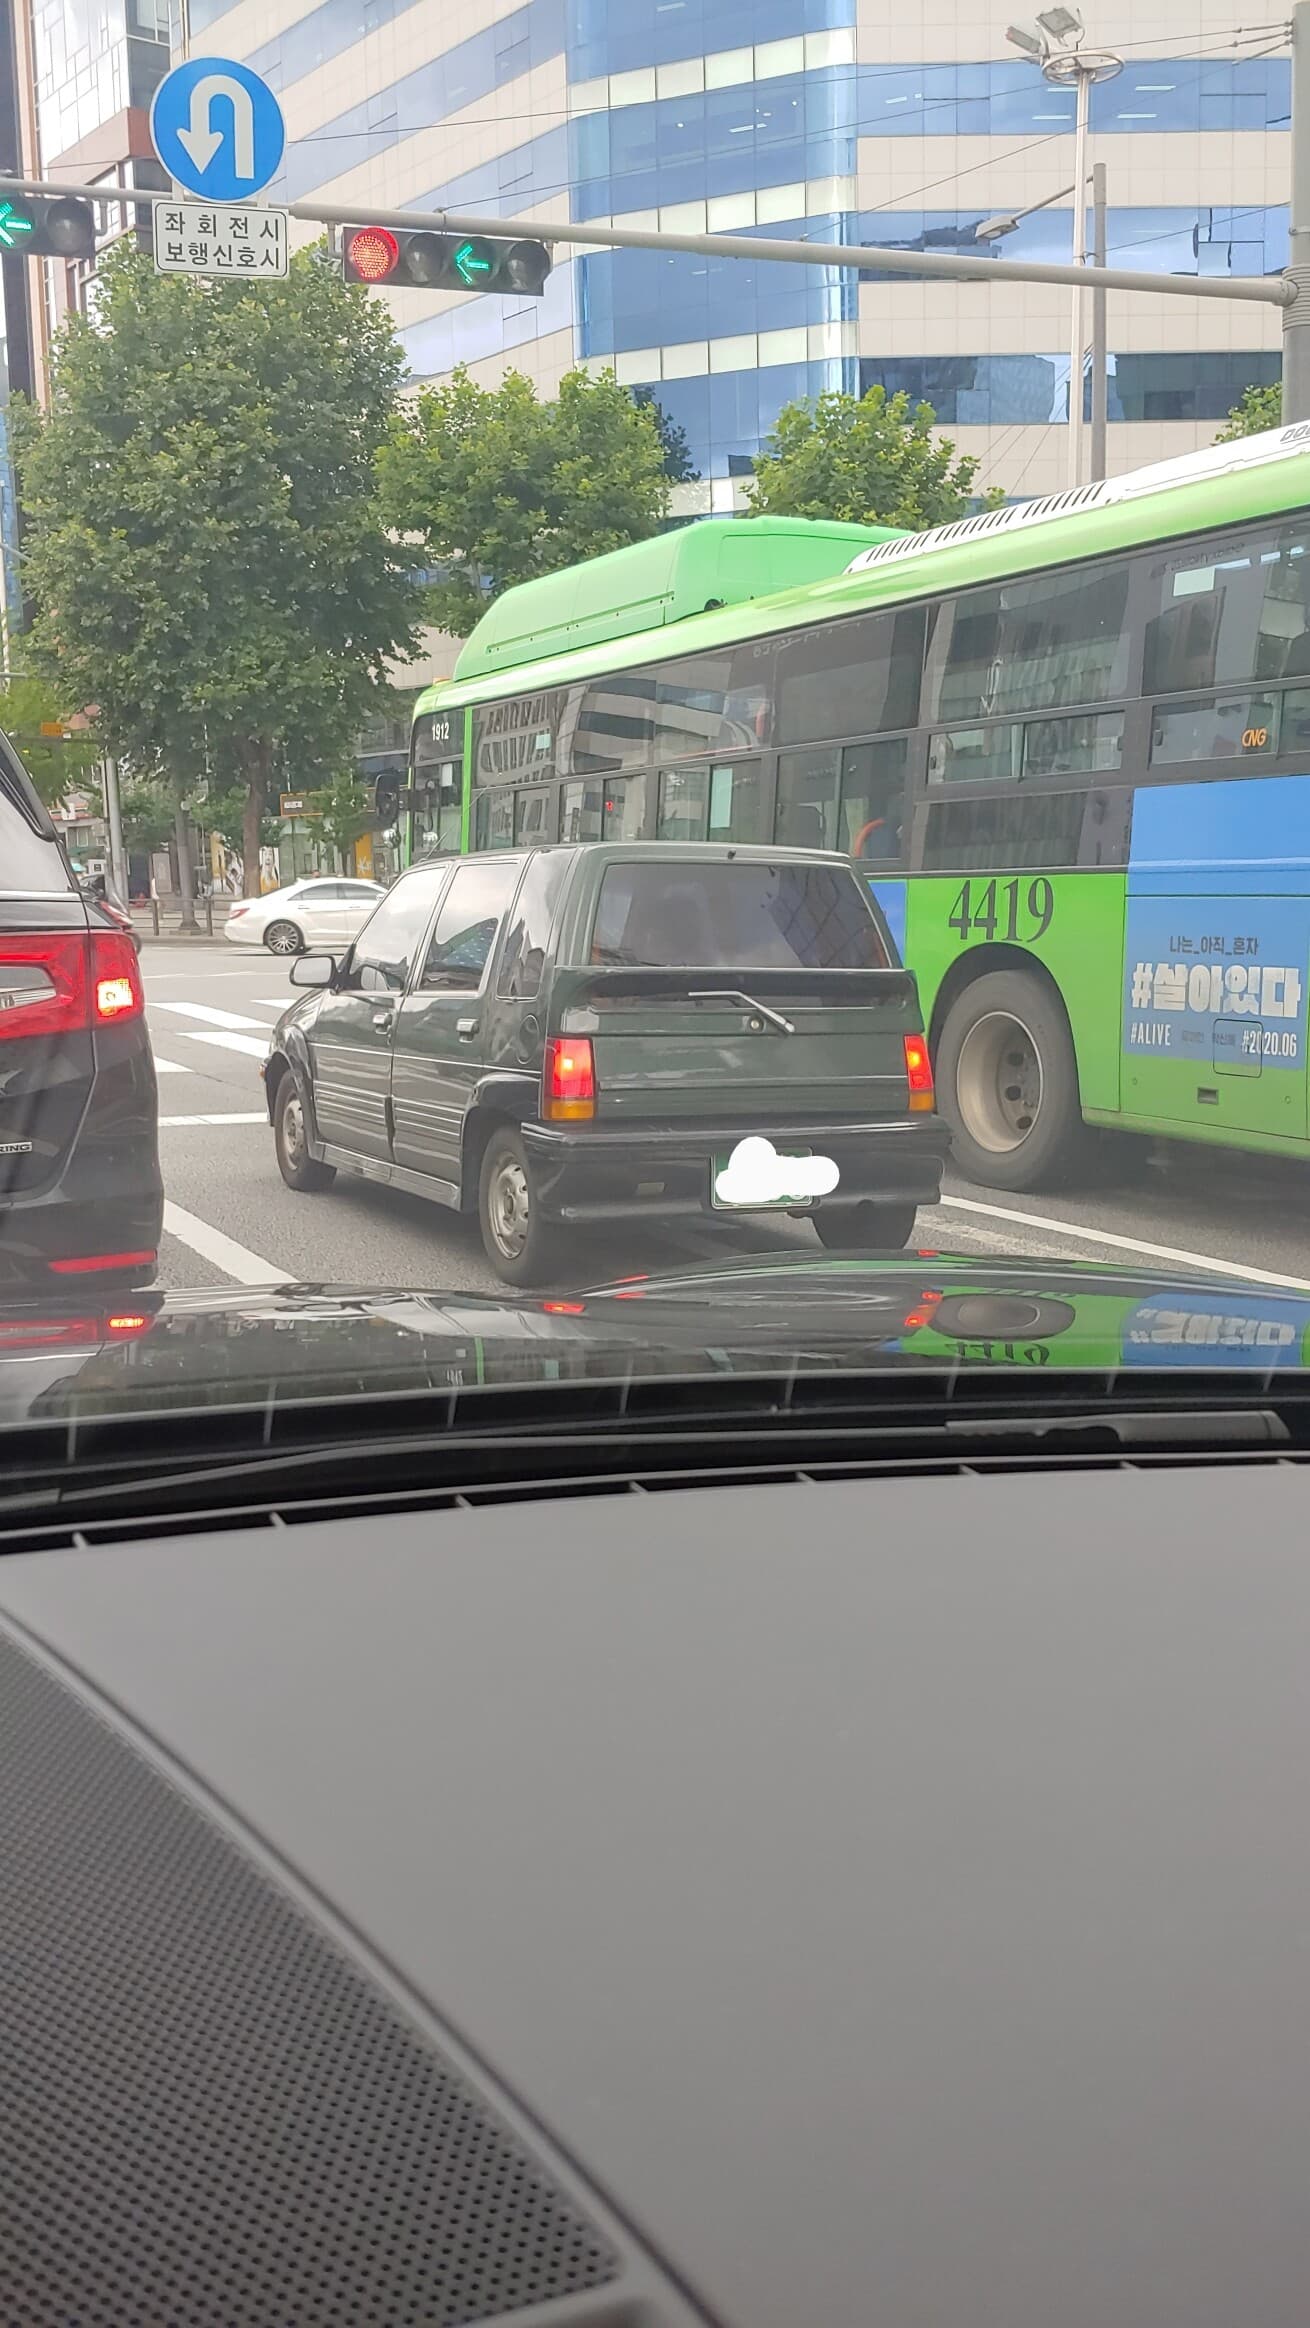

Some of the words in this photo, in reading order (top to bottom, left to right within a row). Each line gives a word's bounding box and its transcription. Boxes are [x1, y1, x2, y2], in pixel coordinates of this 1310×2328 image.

[164, 241, 280, 270] 보행신호시
[431, 722, 450, 741] 1912
[1242, 727, 1267, 747] CNG
[948, 877, 1054, 943] 4419
[1131, 962, 1301, 1018] #살아있다
[1130, 1023, 1172, 1046] #ALIVE
[1241, 1029, 1297, 1057] #2020.06
